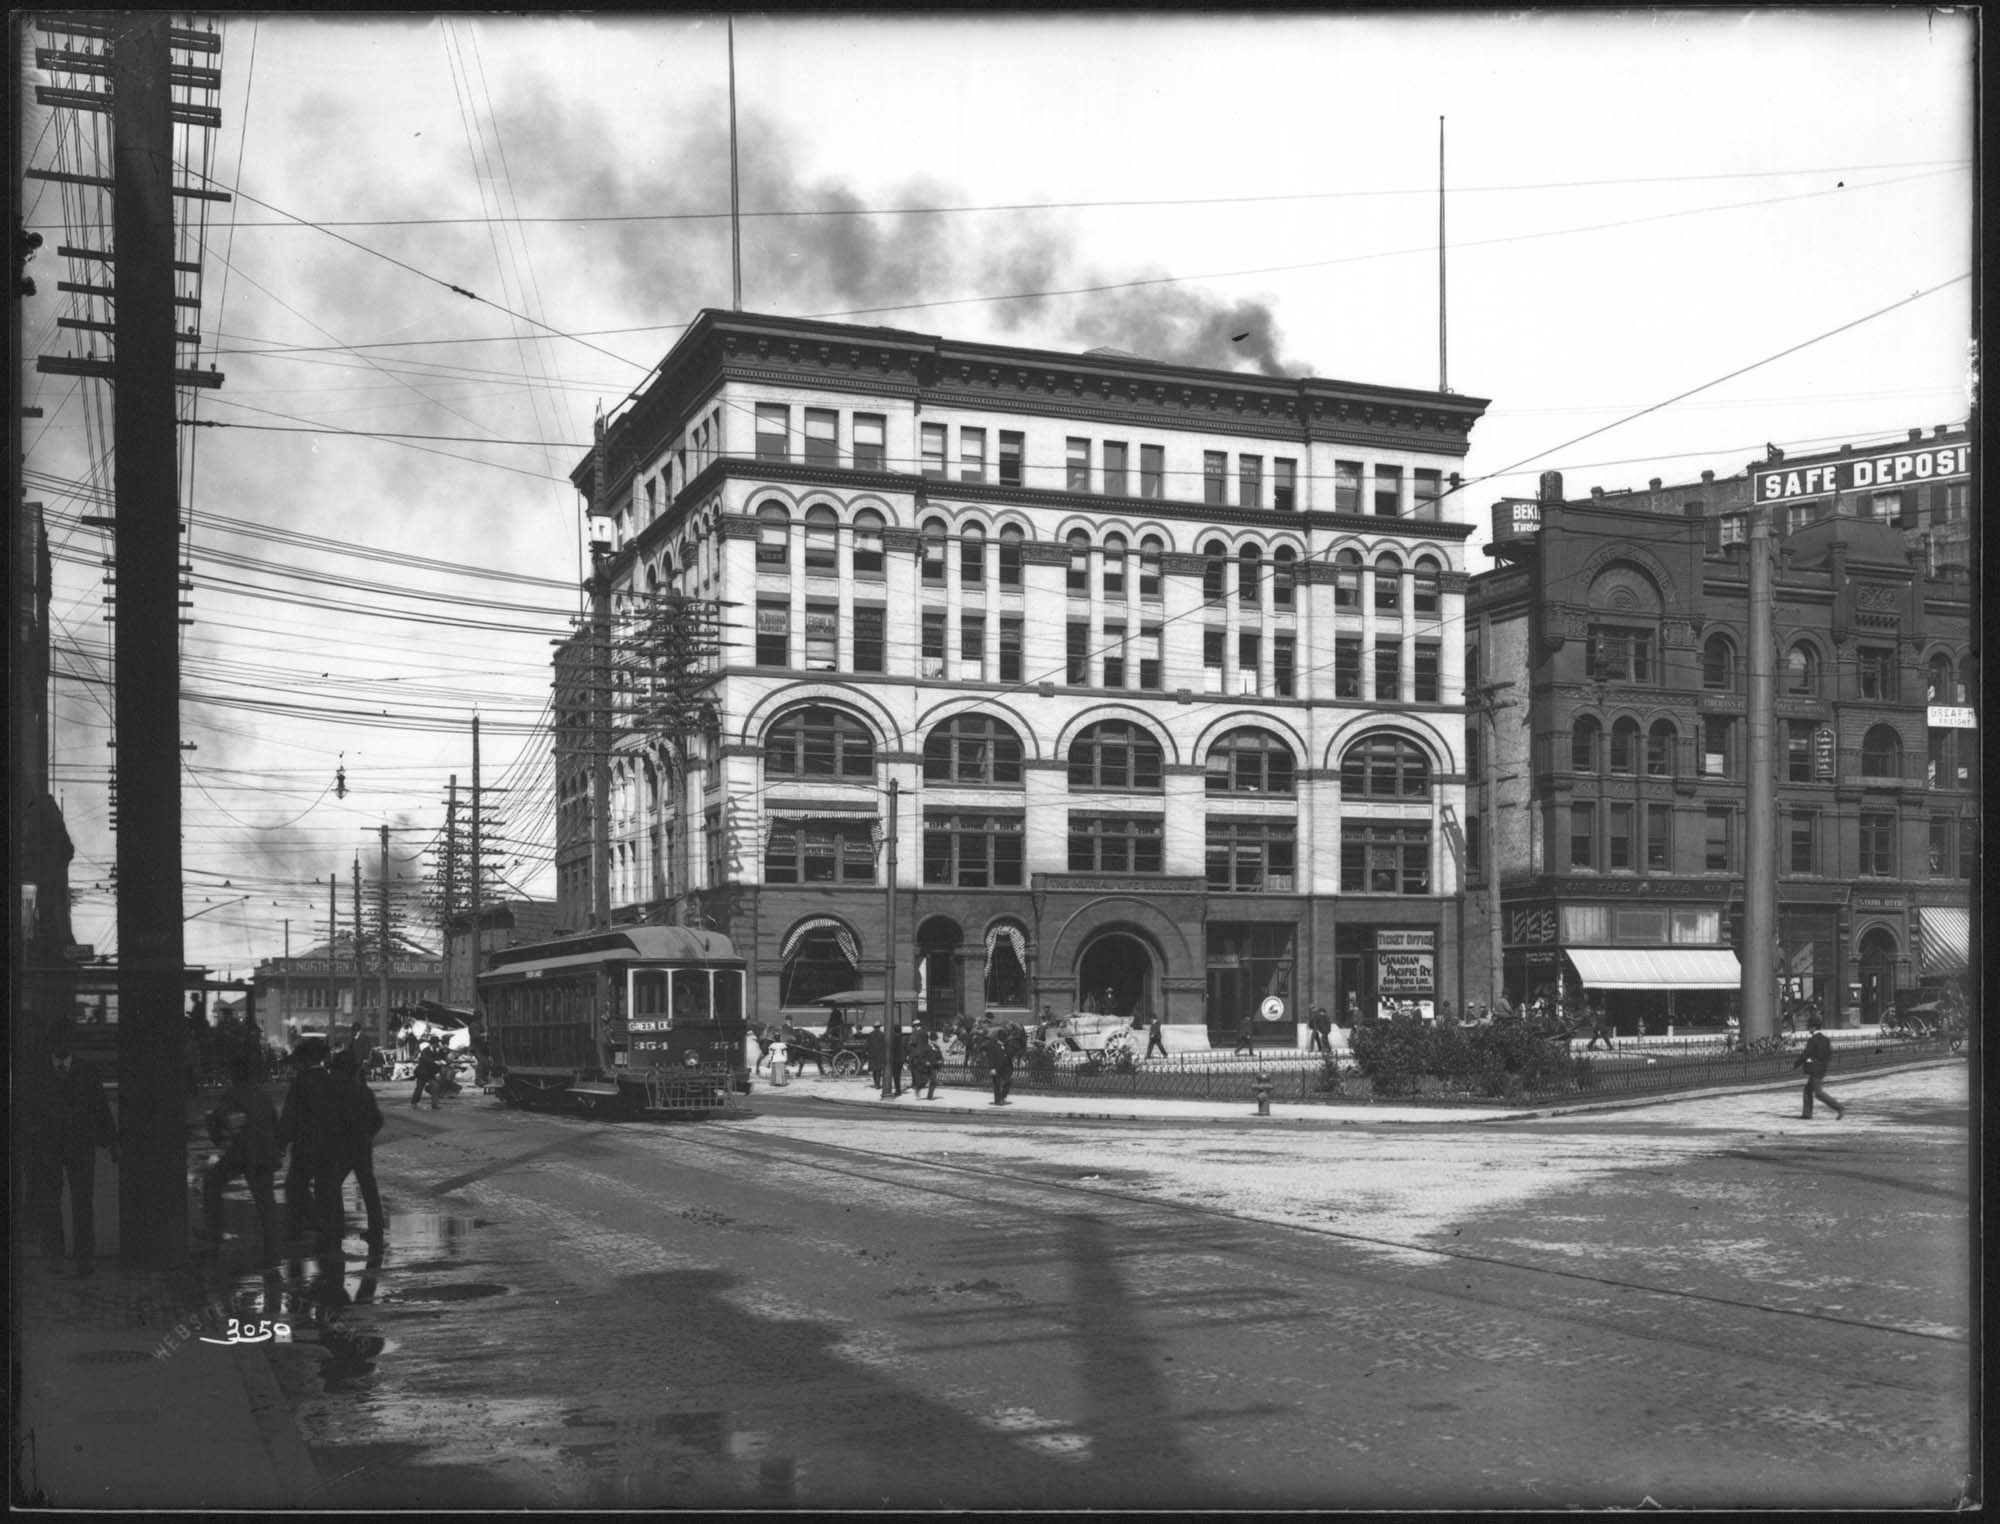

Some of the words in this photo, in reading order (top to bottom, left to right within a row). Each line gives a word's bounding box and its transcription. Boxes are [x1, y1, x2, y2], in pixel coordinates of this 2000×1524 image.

[1764, 466, 1836, 498] SAFE
[1852, 447, 1969, 487] DEPOSI
[1378, 935, 1404, 945] TICKET
[1407, 935, 1433, 946] OFFICE
[628, 1021, 655, 1032] GREEN
